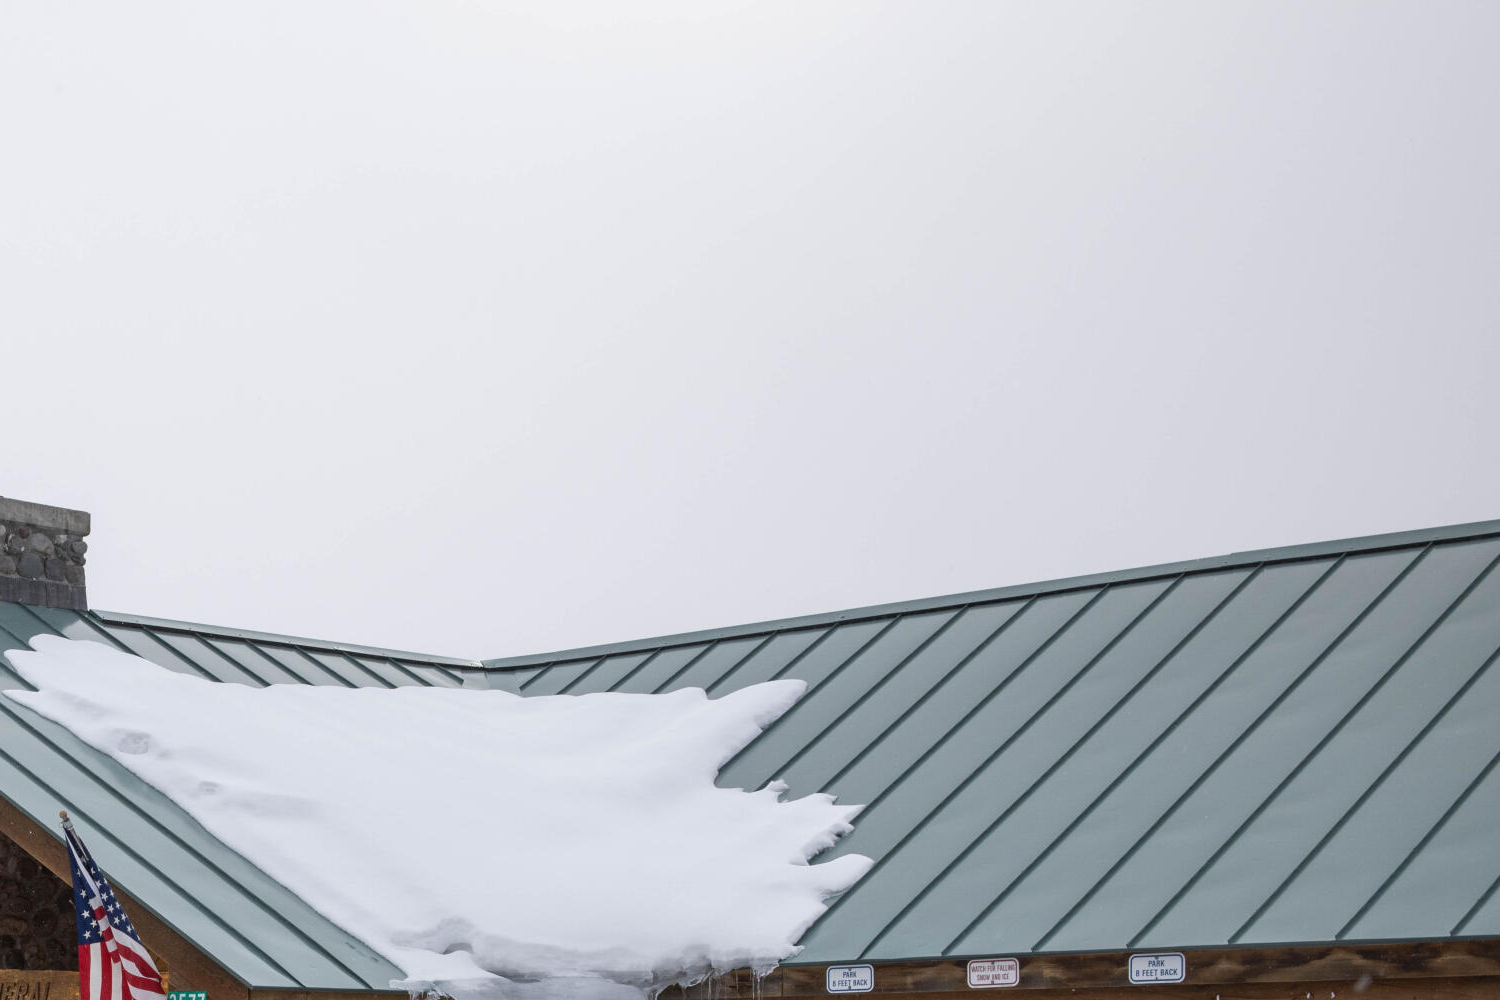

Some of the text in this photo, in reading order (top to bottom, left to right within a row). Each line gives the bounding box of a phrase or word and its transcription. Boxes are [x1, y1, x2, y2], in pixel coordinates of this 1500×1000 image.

[971, 965, 987, 973] WATCH
[1135, 968, 1178, 977] 8 FEET BACK
[842, 971, 857, 979] PARK
[977, 973, 990, 981] SNOW
[838, 979, 850, 987] FEET
[852, 978, 868, 986] BACK
